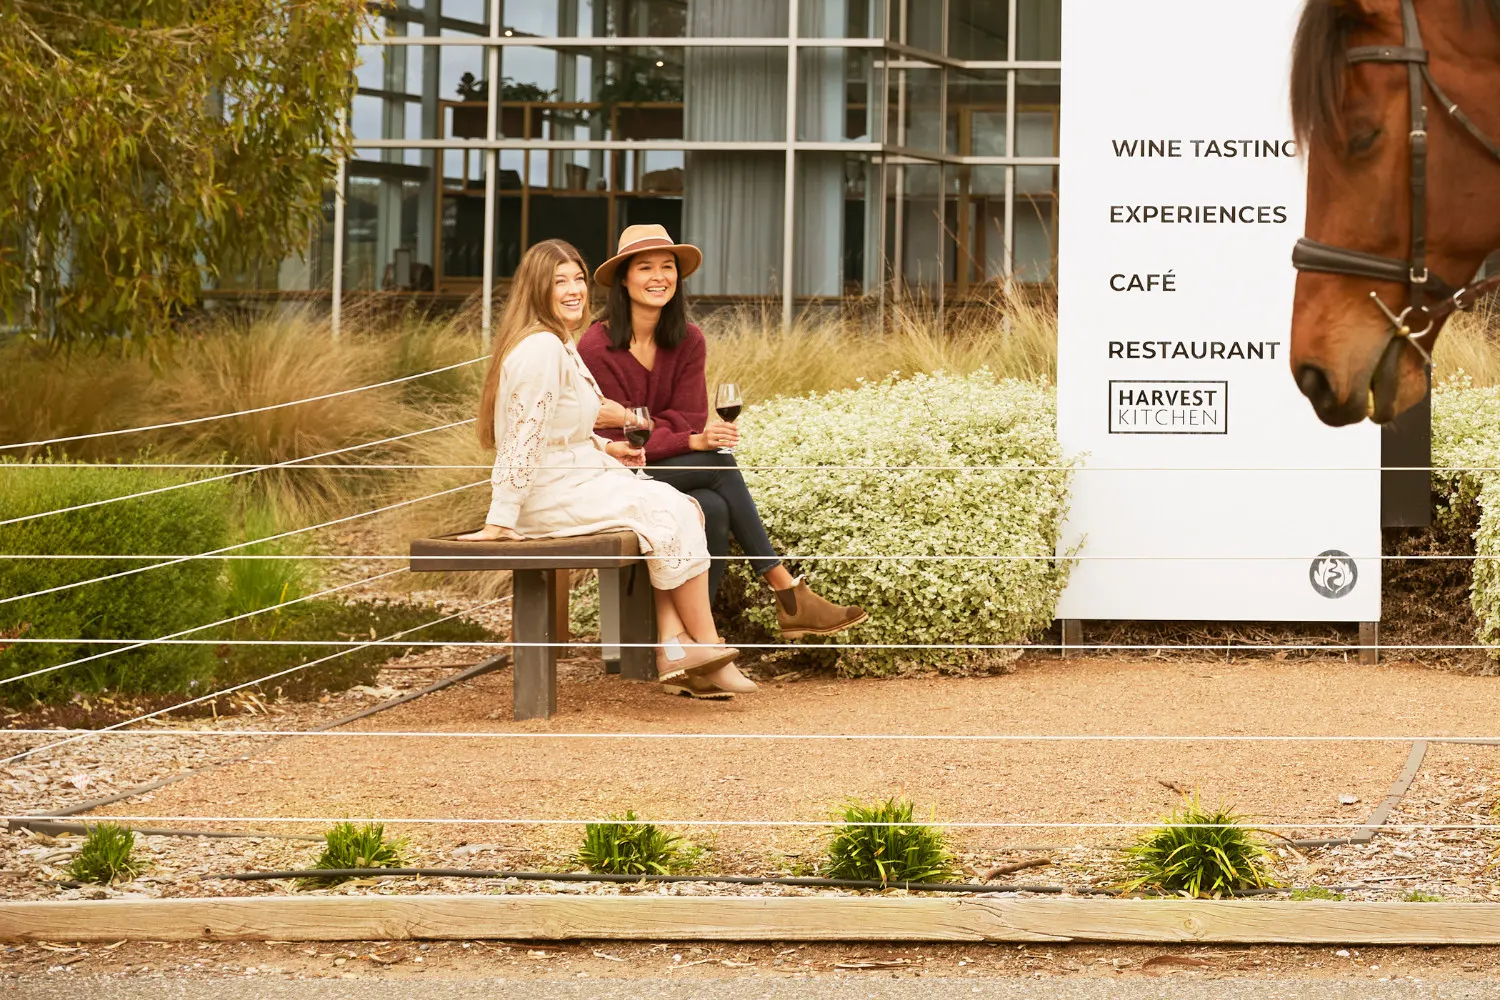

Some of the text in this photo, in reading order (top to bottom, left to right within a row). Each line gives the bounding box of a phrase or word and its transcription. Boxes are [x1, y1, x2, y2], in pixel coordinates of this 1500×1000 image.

[1111, 139, 1182, 158] WINE
[1110, 205, 1288, 224] EXPERIENCES
[1109, 269, 1176, 292] CAFÉ
[1108, 340, 1281, 360] RESTAURANT
[1119, 389, 1218, 407] HARVEST
[1118, 409, 1217, 426] KITCHEN
